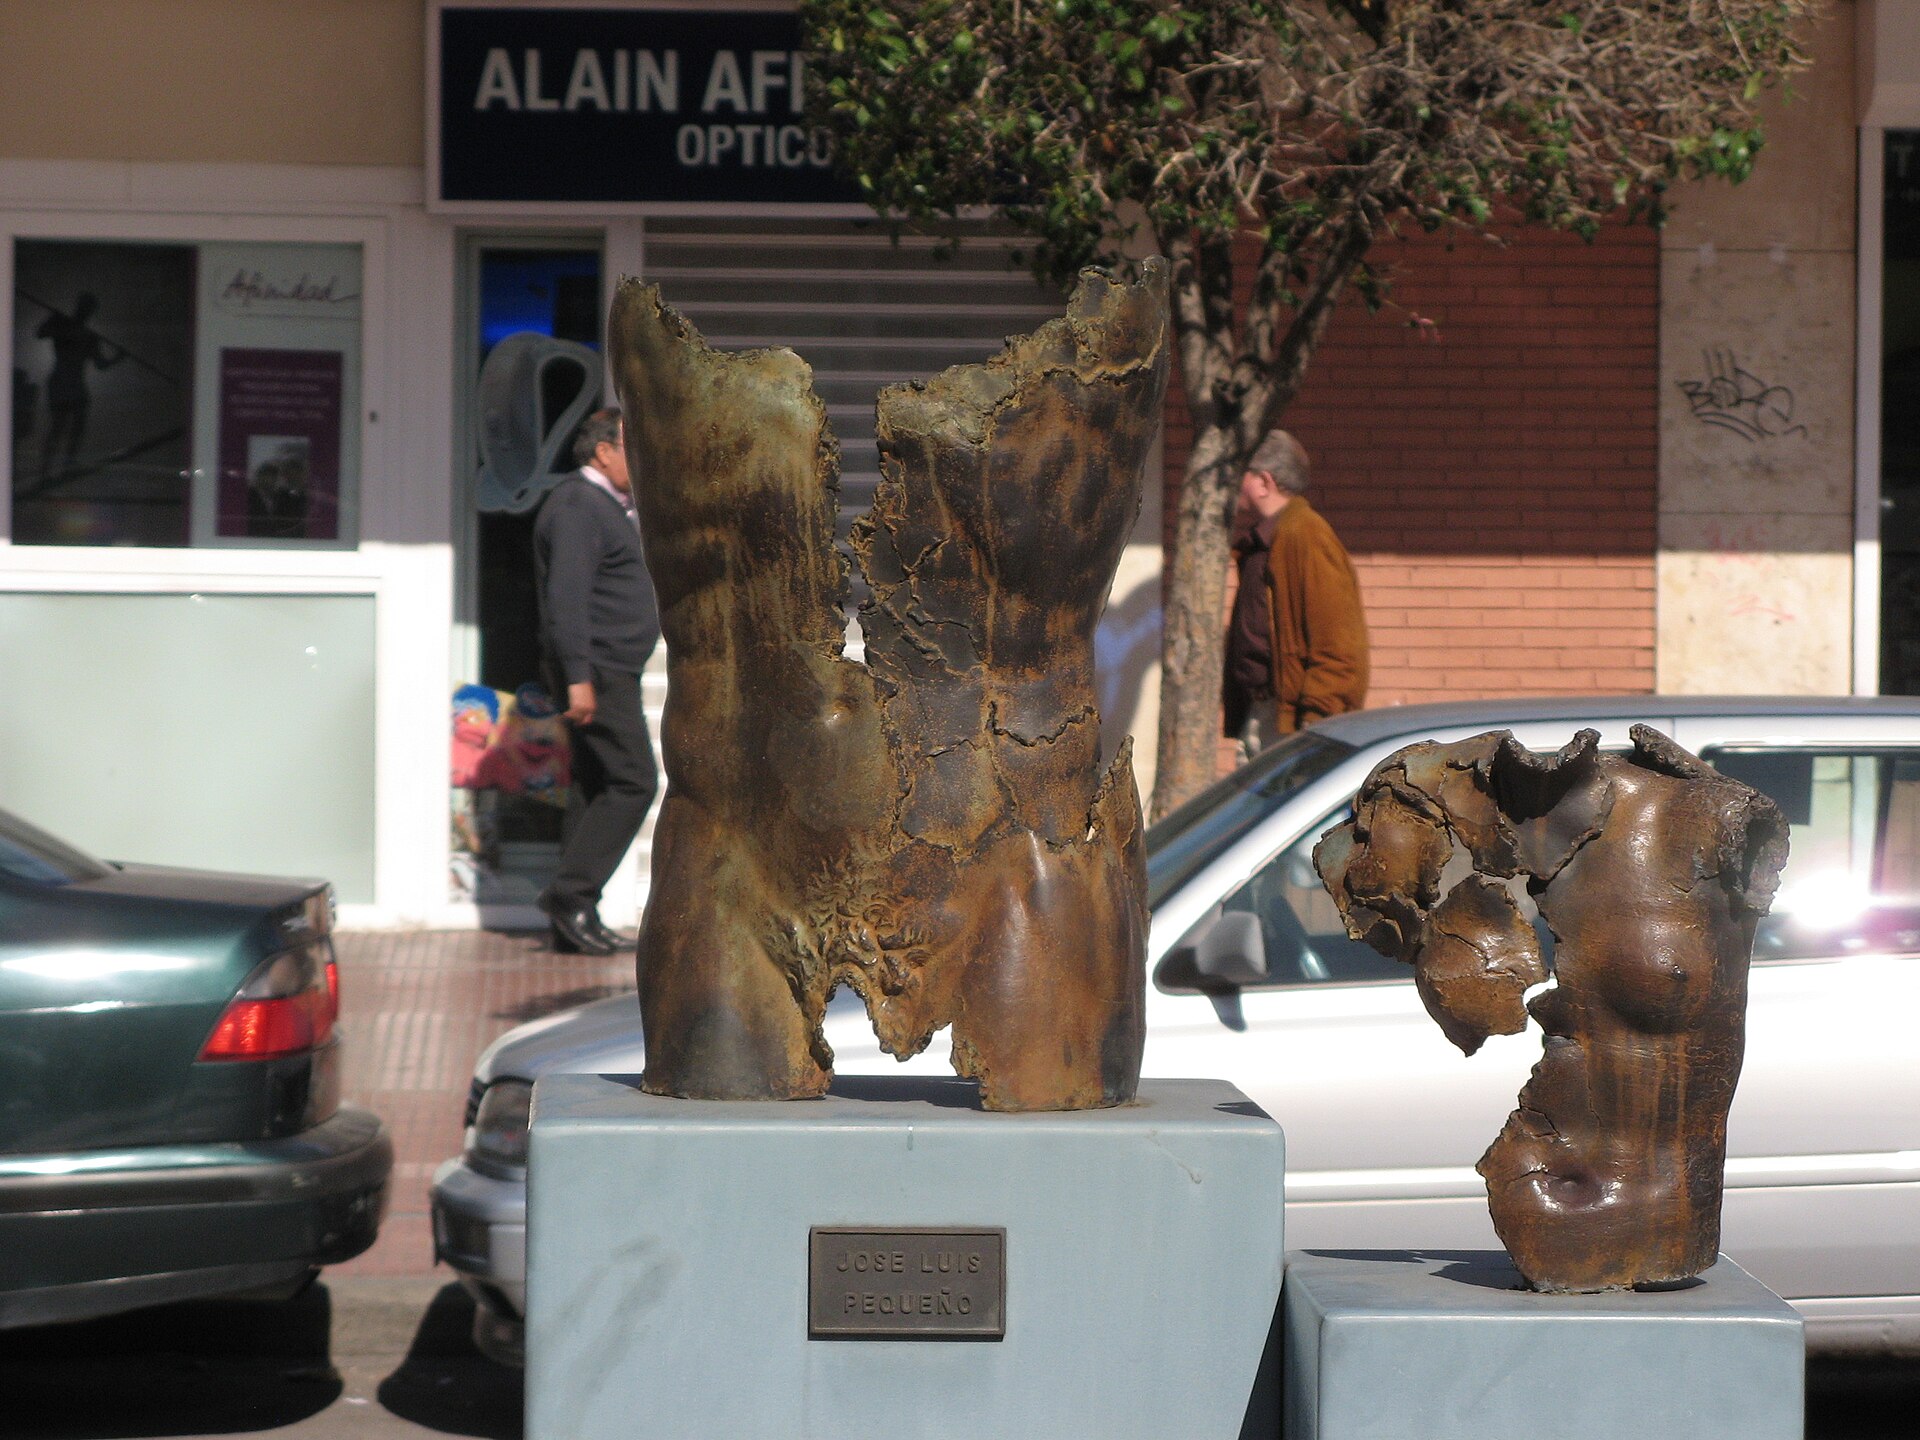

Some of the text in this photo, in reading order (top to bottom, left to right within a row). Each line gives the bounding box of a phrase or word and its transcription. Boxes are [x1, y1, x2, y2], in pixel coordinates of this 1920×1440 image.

[474, 47, 680, 112] ALAIN
[836, 1250, 982, 1274] JOSE LUIS
[843, 1285, 973, 1315] PEQUEÑO
